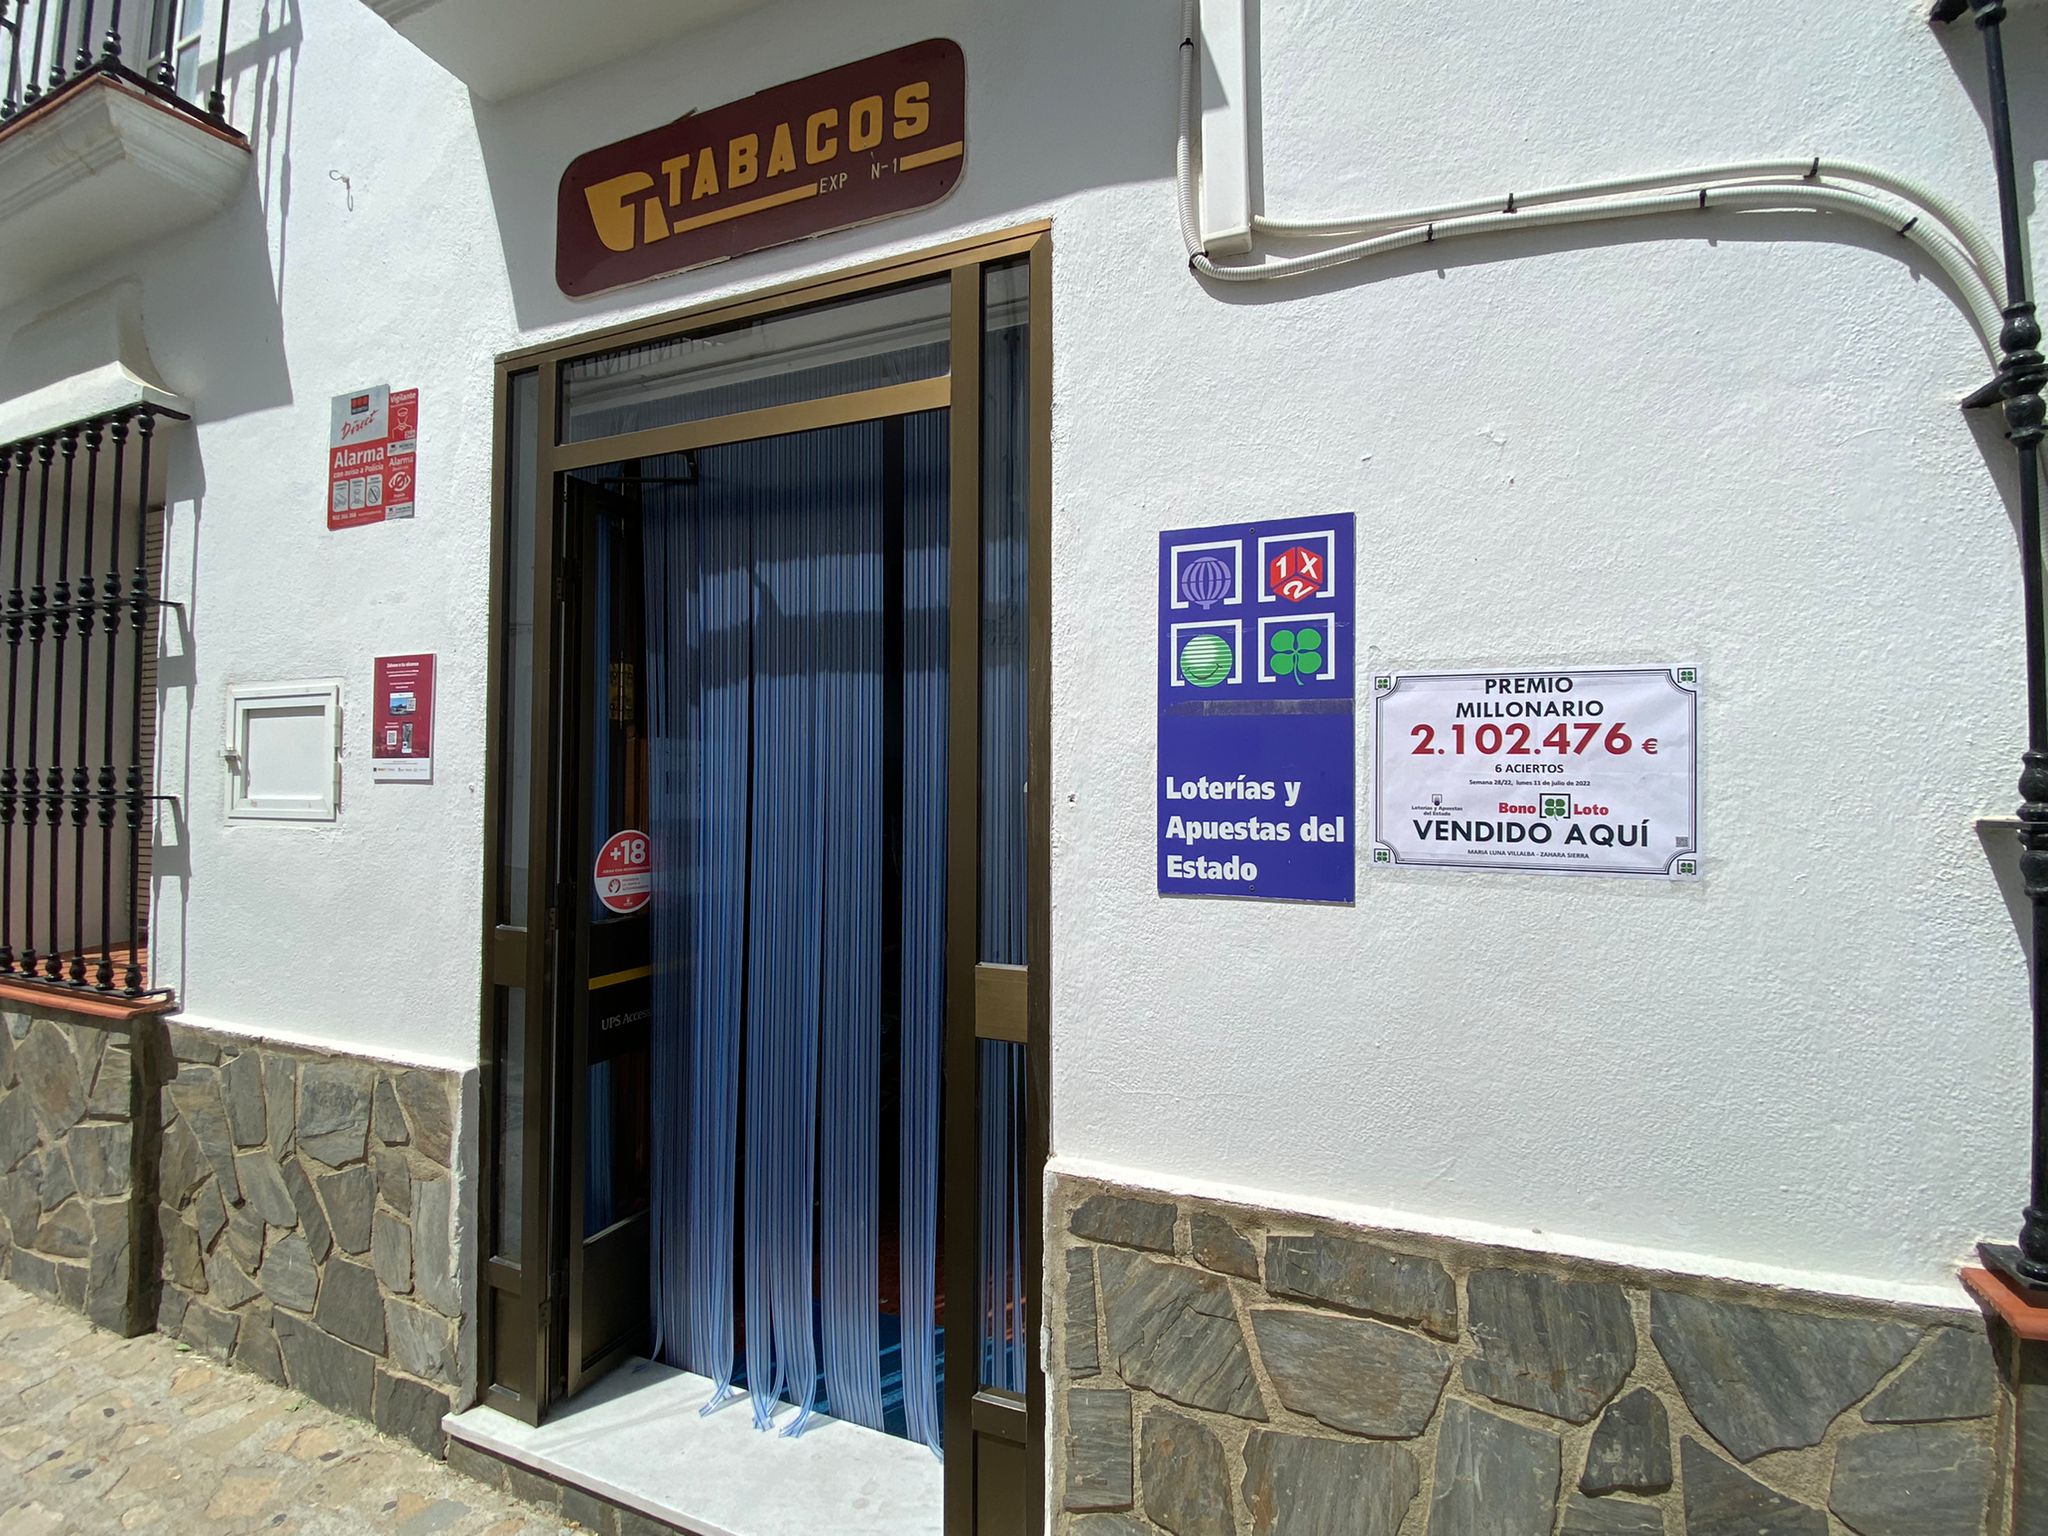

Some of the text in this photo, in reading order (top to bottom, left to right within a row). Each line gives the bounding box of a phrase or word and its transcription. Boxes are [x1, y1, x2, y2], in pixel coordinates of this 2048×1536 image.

[661, 81, 930, 207] TABACOS
[820, 172, 848, 194] EXP
[334, 447, 384, 468] Alarma
[389, 456, 414, 466] Alarma
[1276, 555, 1287, 579] 1
[1283, 580, 1314, 600] 2
[1485, 677, 1573, 695] PREMIO
[1456, 700, 1604, 718] MILLONARIO
[1411, 722, 1658, 755] 2.102.476 €
[1495, 764, 1564, 774] 6 ACIERTOS
[1166, 774, 1301, 807] Loterías y
[1498, 802, 1609, 816] Bono Loto
[1165, 816, 1345, 845] Apuestas del
[1412, 819, 1650, 847] VENDIDO AQUÍ
[610, 839, 646, 865] +18
[1166, 855, 1258, 881] Estado
[601, 1014, 622, 1031] UPS
